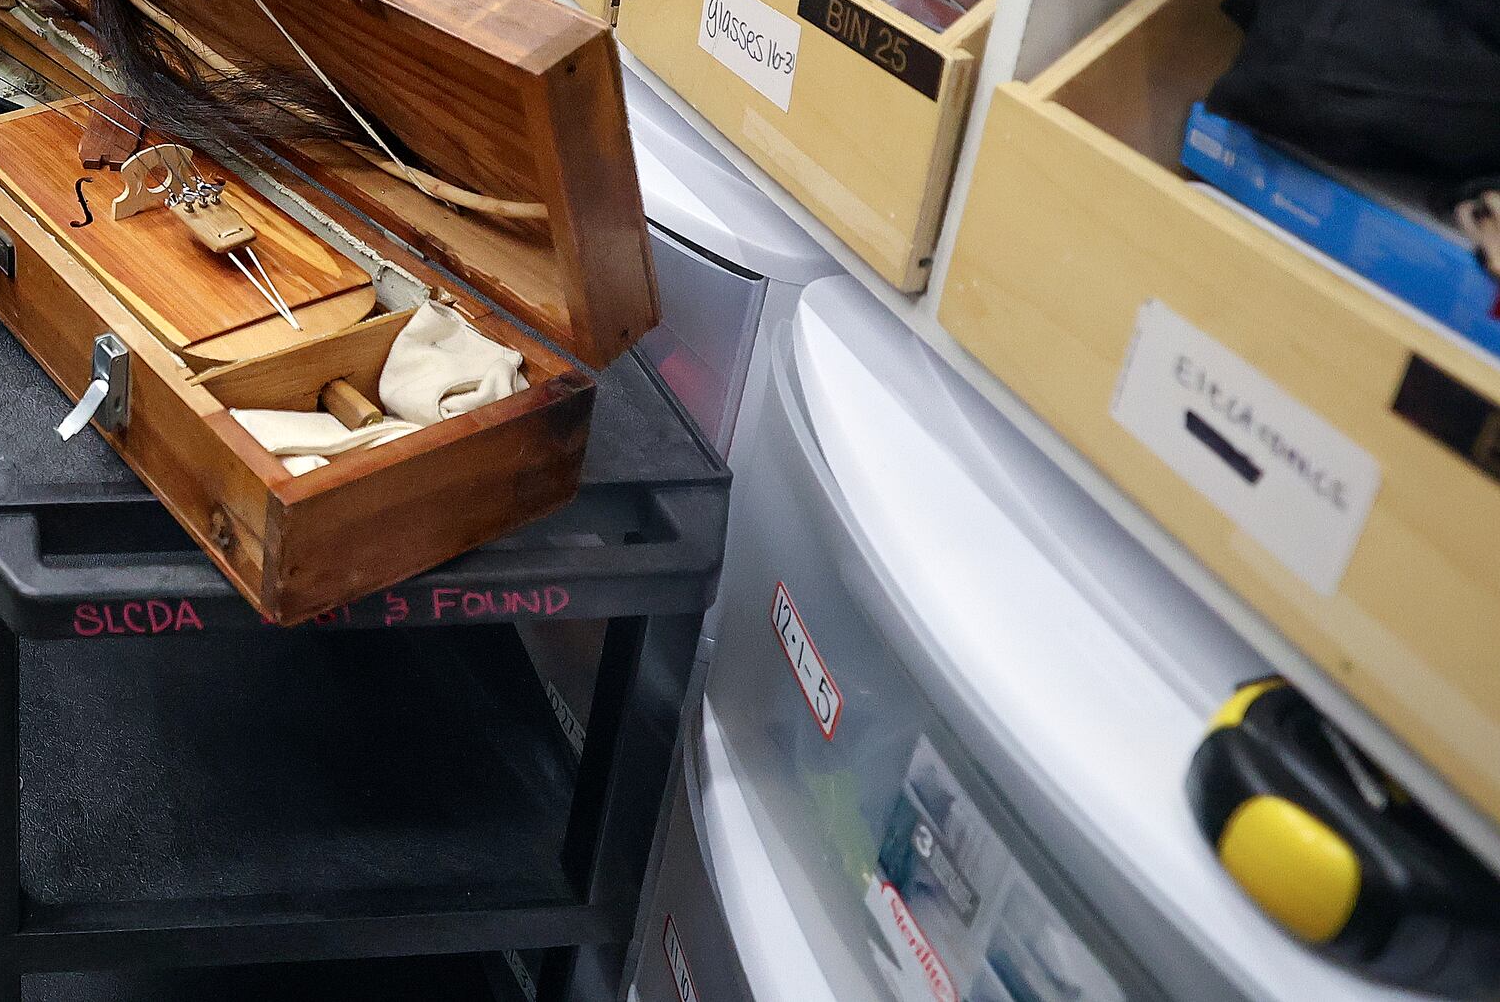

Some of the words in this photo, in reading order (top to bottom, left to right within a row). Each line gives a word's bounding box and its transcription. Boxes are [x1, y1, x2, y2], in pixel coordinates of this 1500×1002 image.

[875, 28, 908, 74] 25
[73, 599, 204, 636] SLCDA
[432, 586, 570, 618] FOUND
